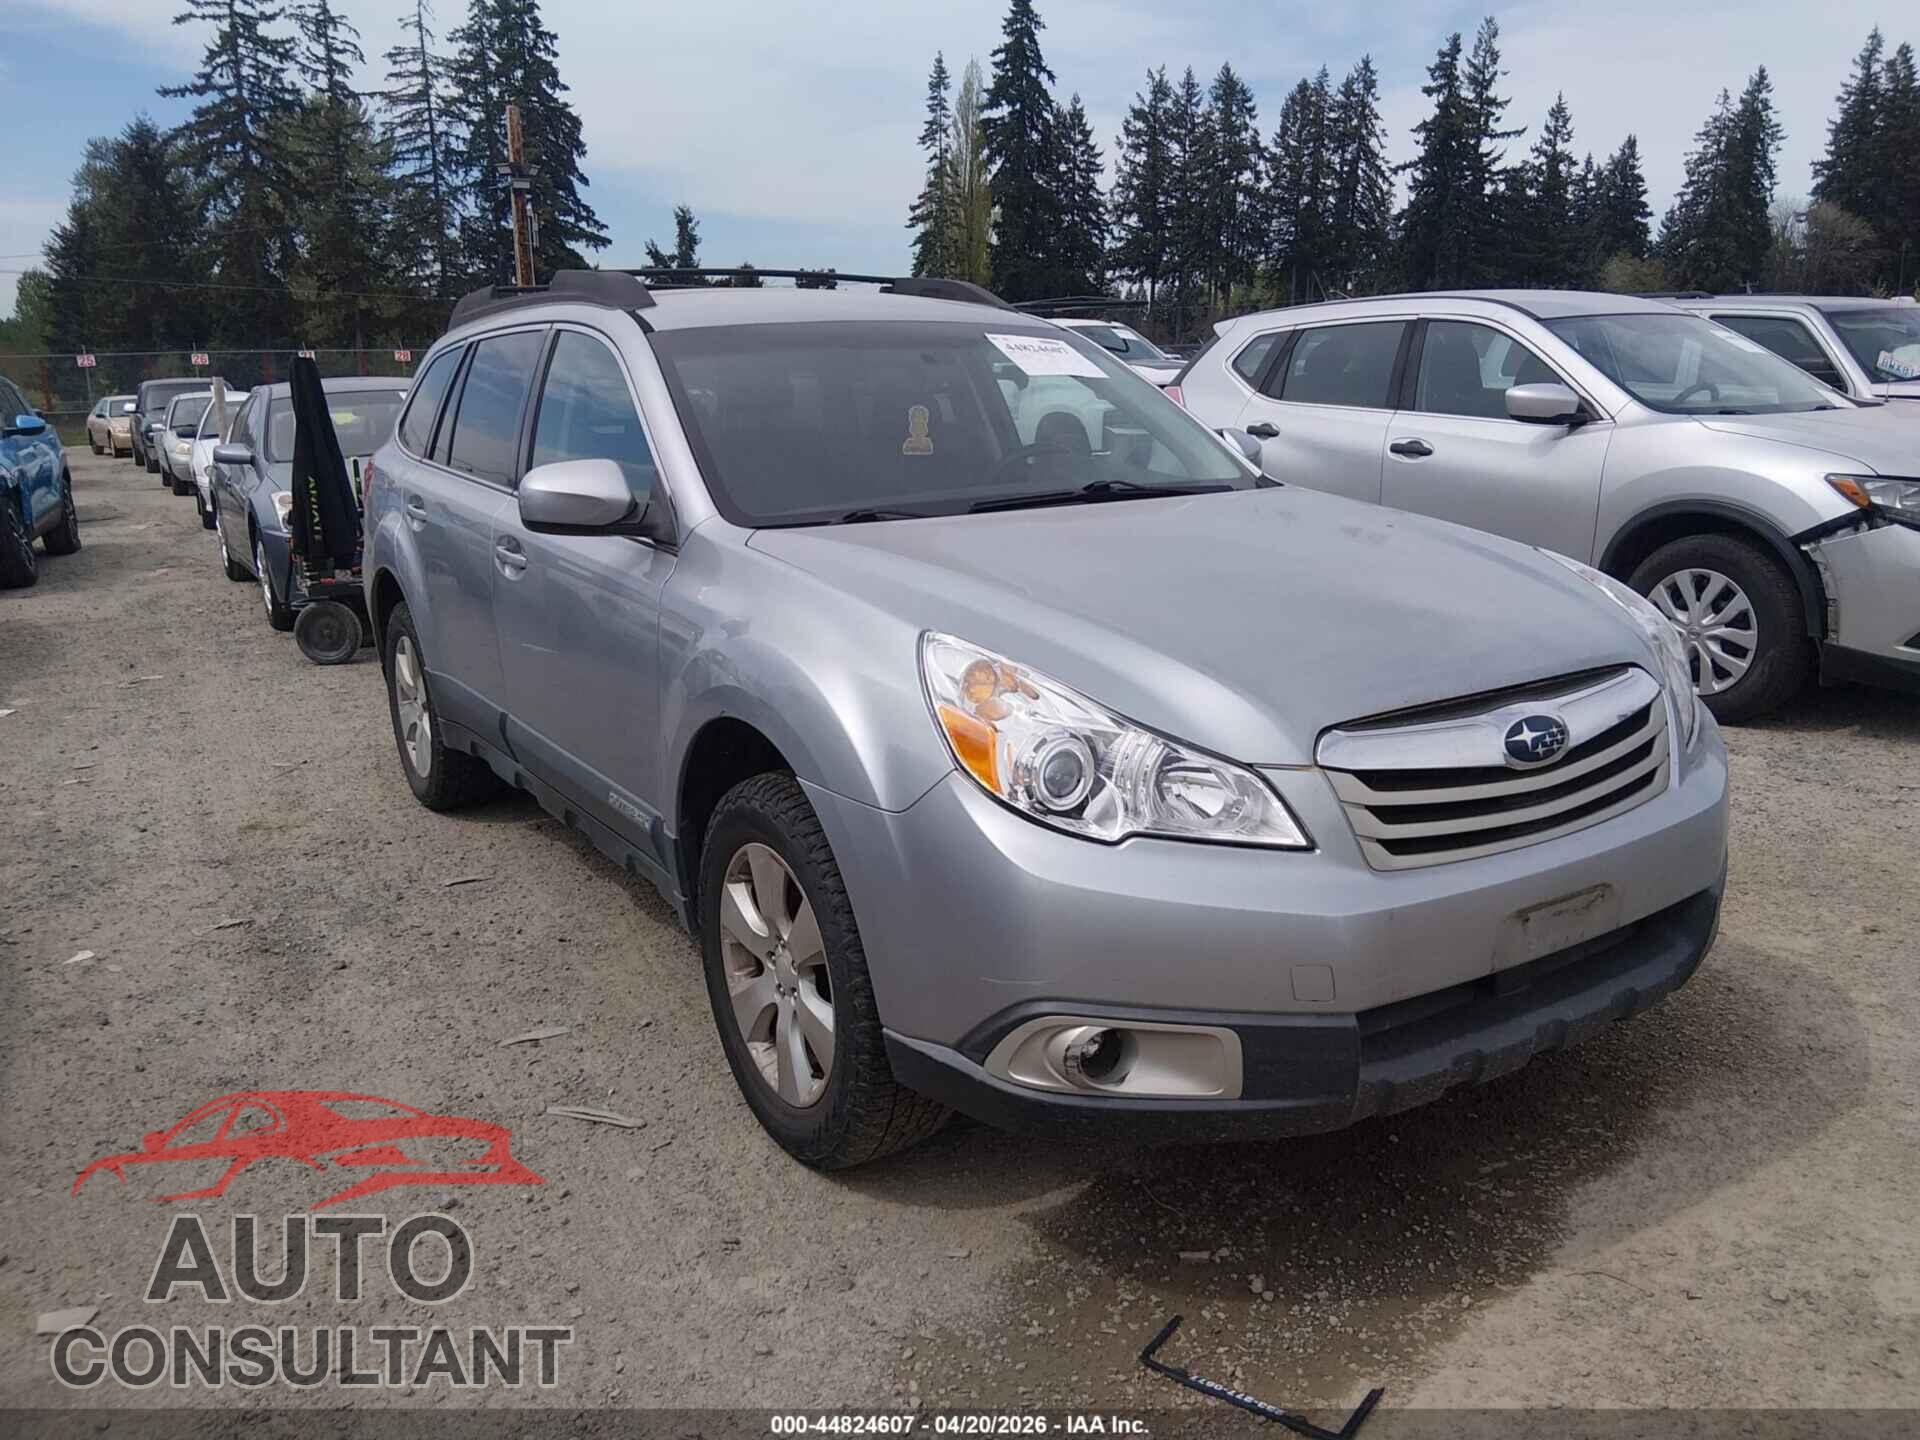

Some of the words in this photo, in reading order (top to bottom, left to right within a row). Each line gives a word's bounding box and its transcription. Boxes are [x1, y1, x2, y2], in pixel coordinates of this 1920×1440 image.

[79, 354, 94, 366] 25
[193, 354, 208, 364] 26
[397, 351, 409, 361] 28
